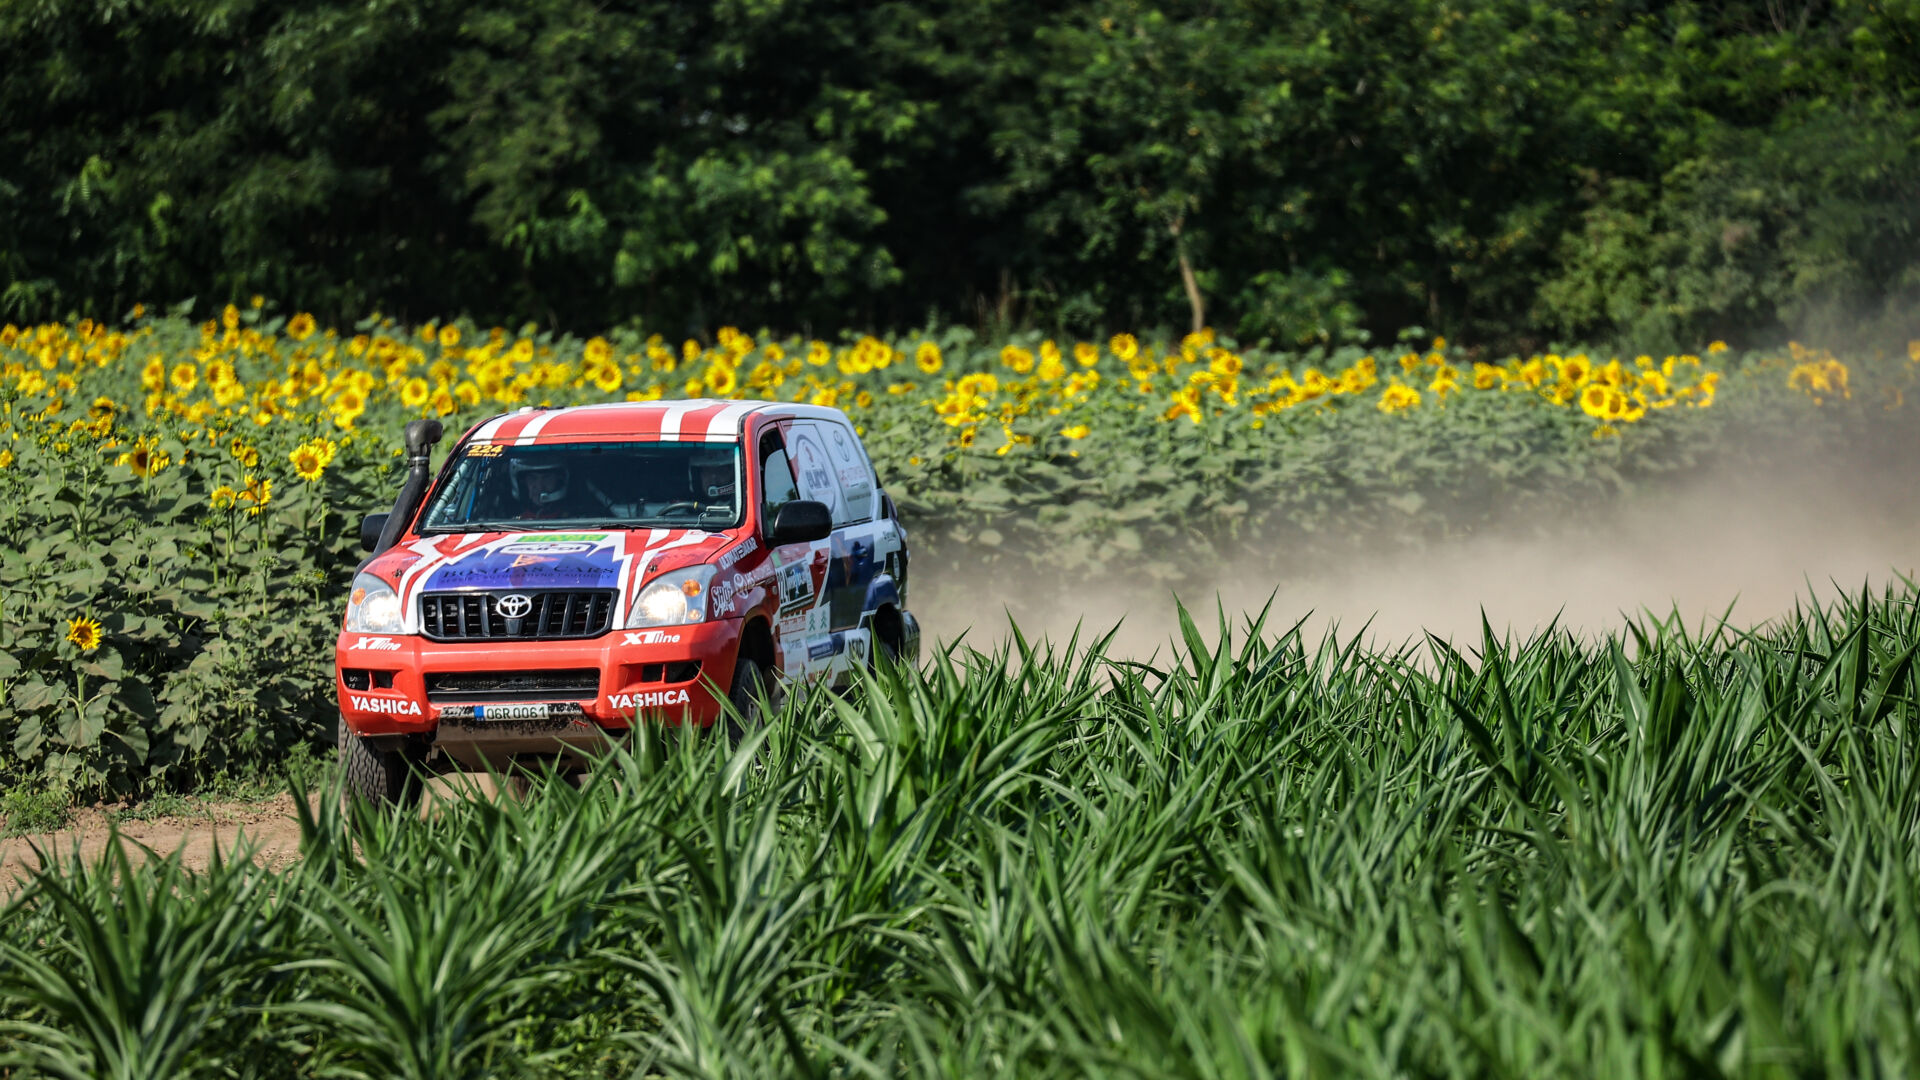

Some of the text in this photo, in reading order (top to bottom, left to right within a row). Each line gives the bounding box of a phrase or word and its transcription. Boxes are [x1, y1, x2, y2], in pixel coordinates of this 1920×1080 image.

[468, 445, 504, 455] 224
[350, 695, 422, 716] YASHICA
[607, 689, 690, 709] YASHICA
[512, 706, 547, 719] 0061
